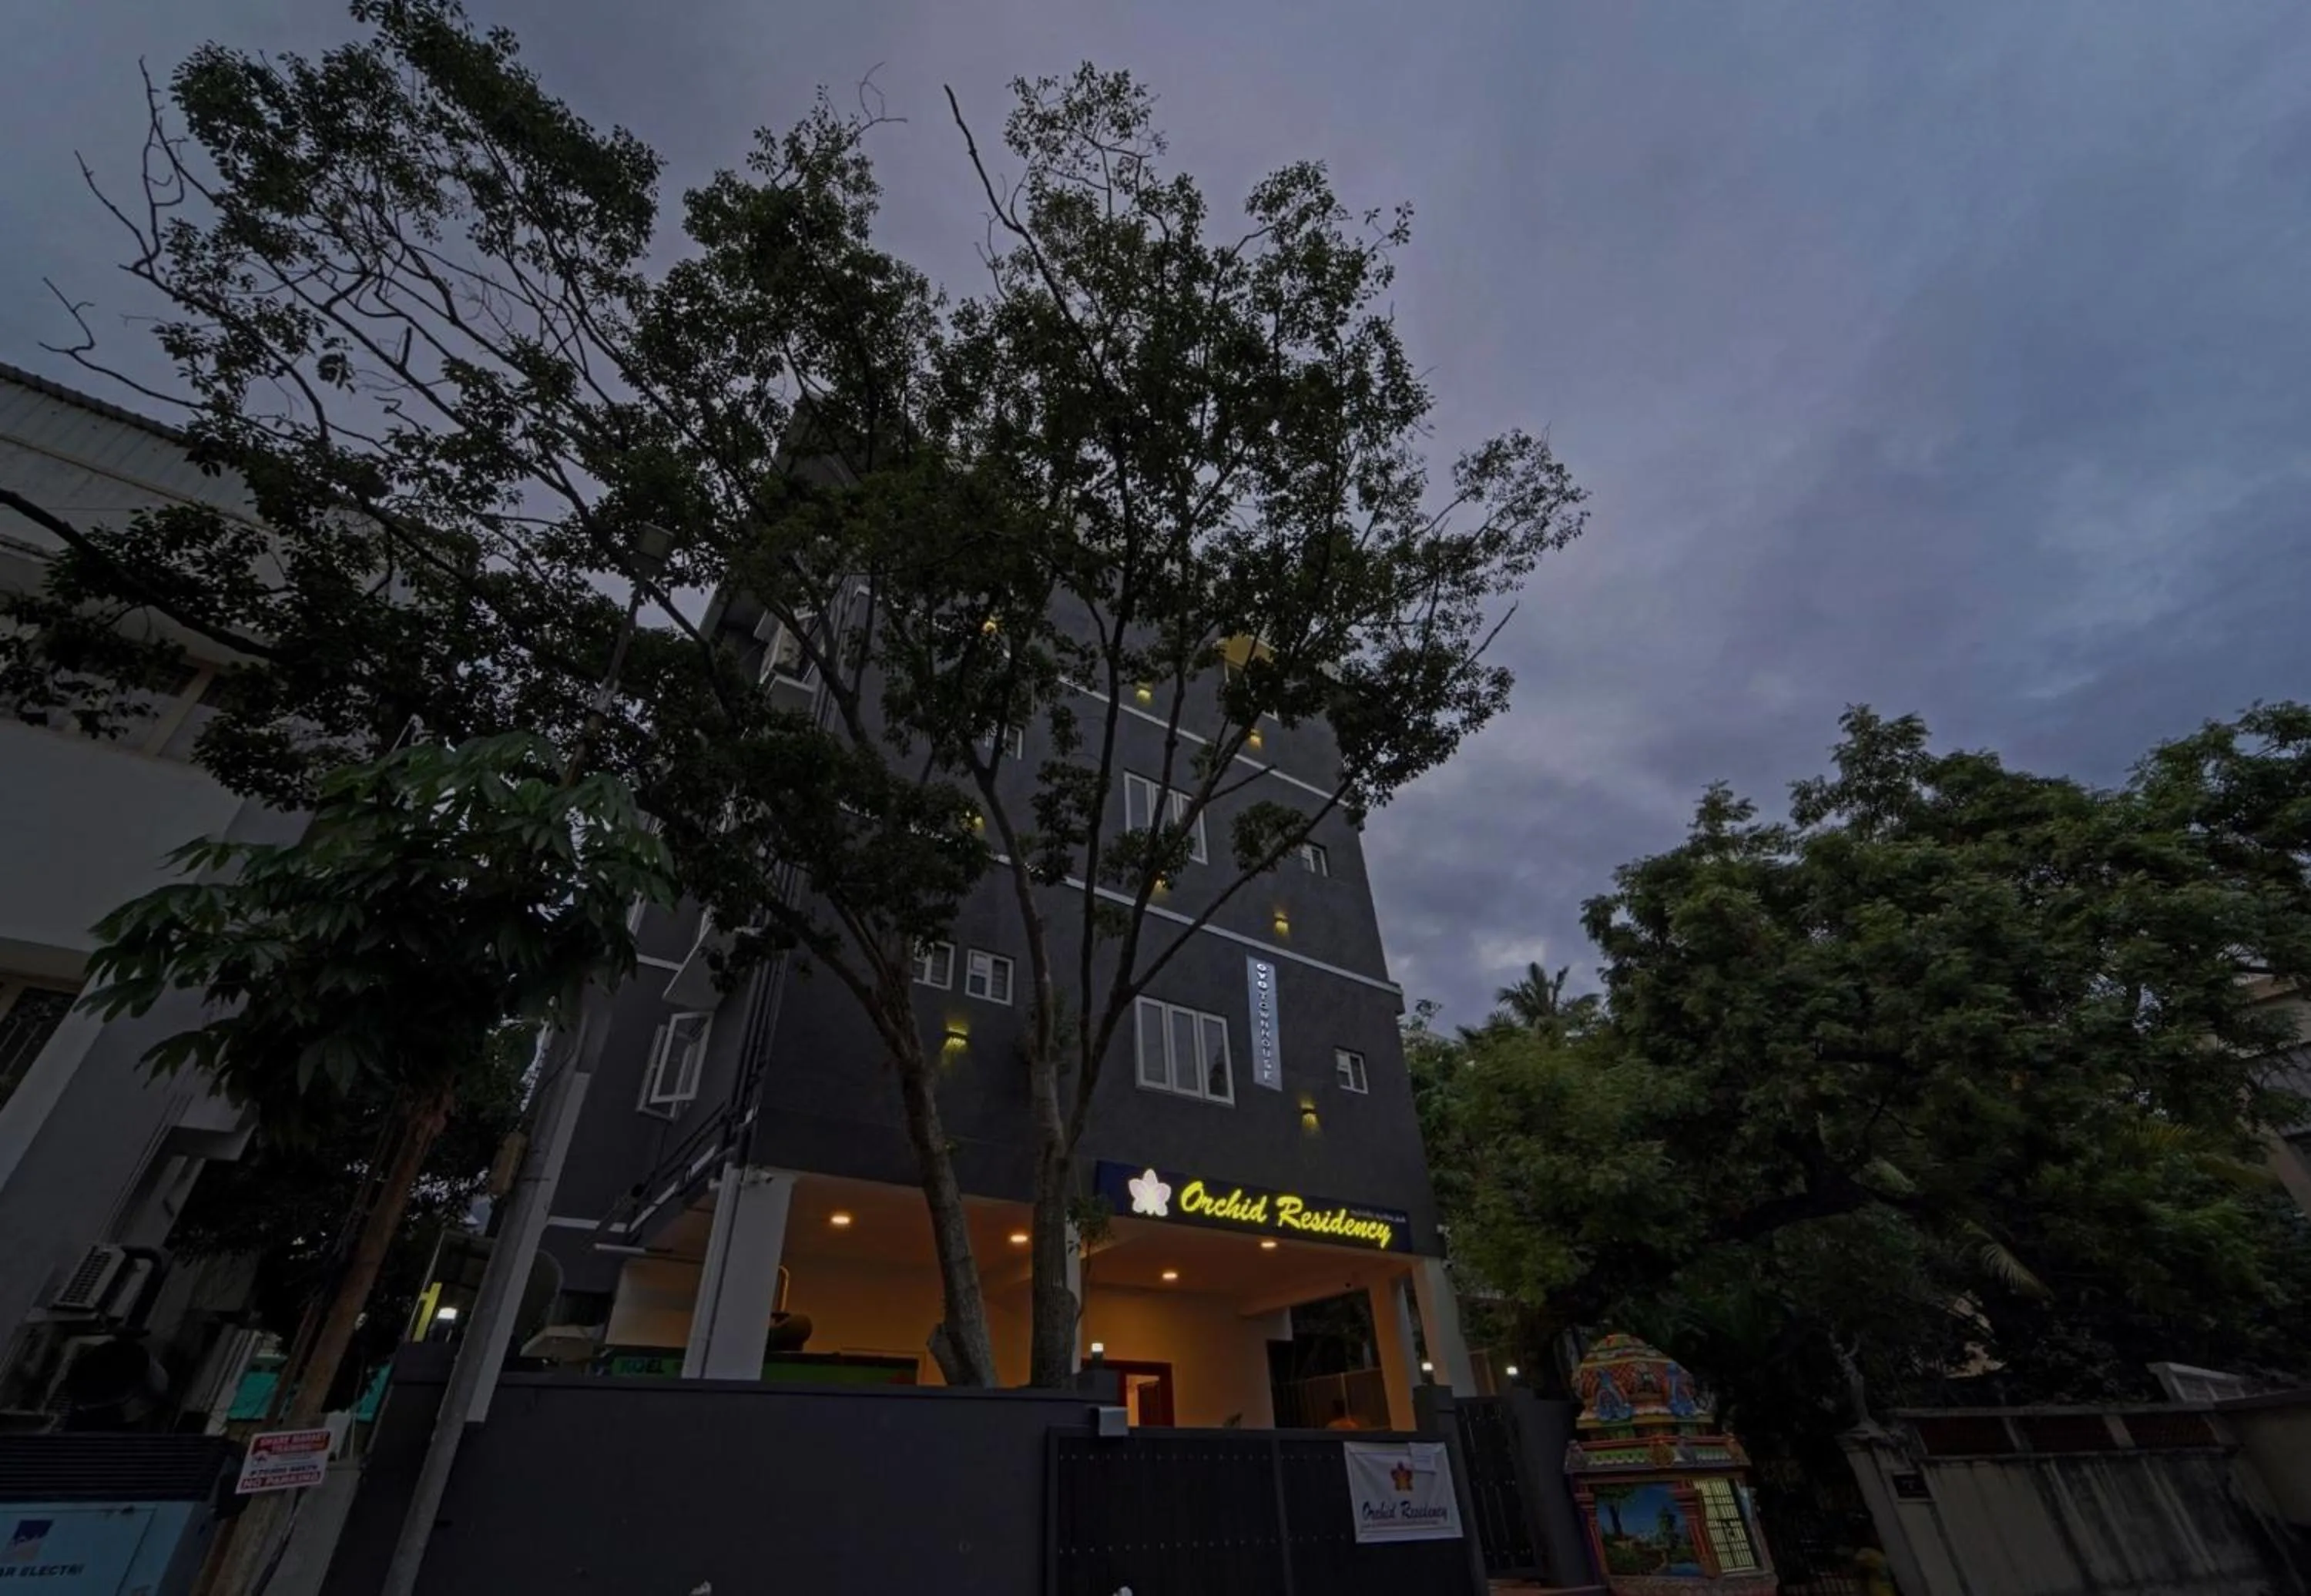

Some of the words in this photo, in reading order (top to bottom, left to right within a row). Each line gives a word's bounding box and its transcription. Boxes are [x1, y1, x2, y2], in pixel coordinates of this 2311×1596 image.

[1179, 1180, 1269, 1225] Orchid
[1276, 1194, 1394, 1249] Residency
[242, 1478, 261, 1489] NO
[264, 1471, 320, 1487] PARKING
[1363, 1500, 1396, 1521] Orchid
[1400, 1500, 1447, 1522] Residency
